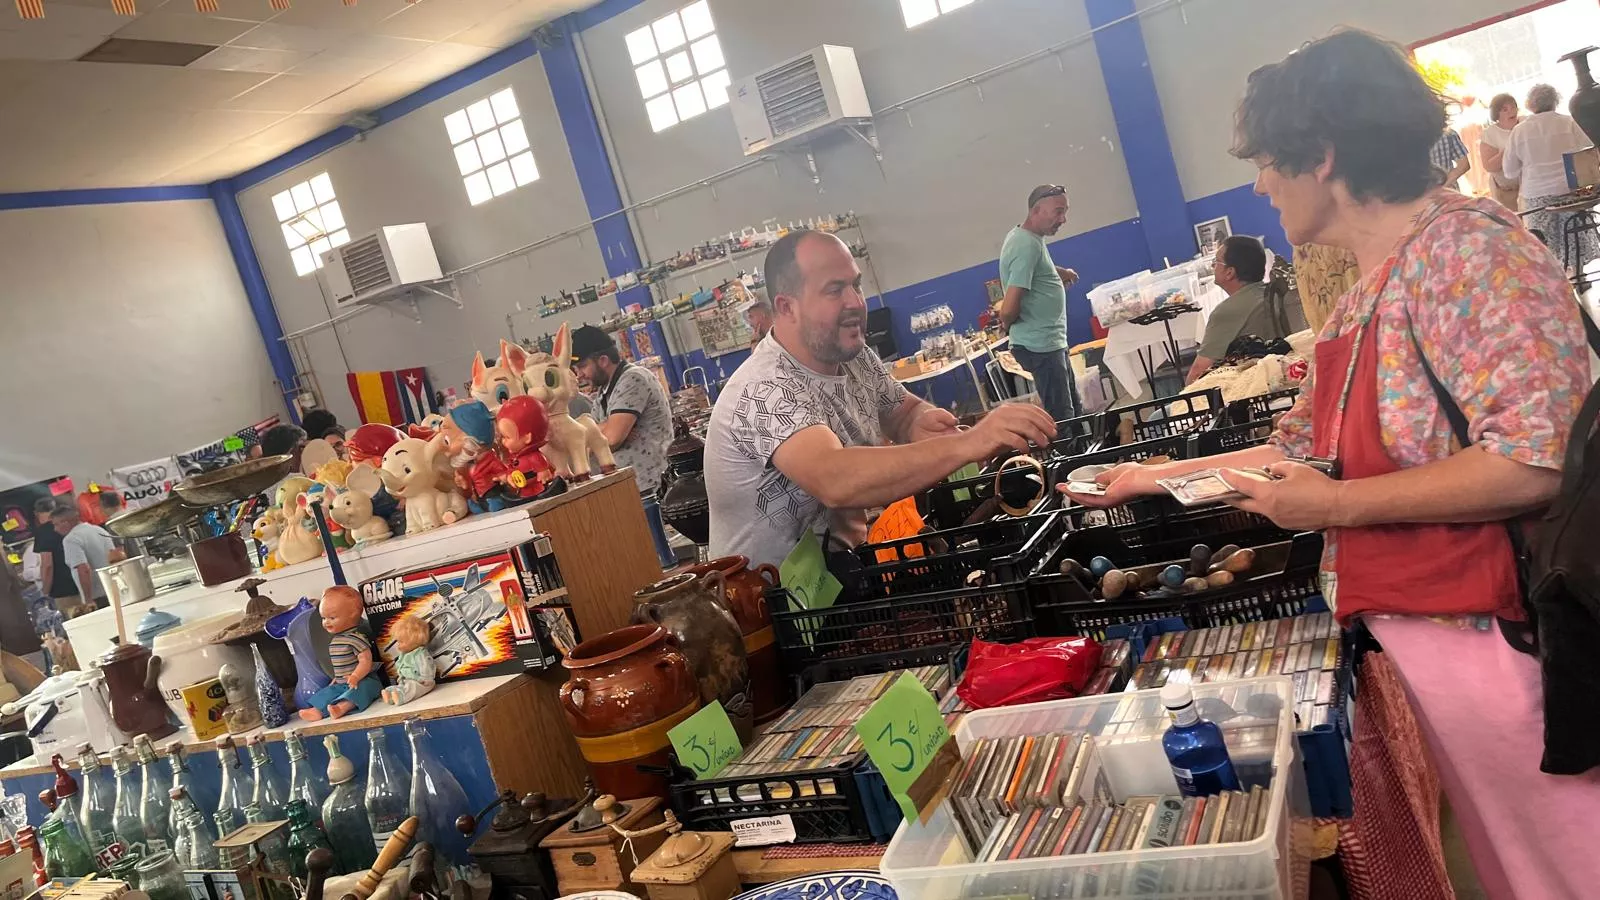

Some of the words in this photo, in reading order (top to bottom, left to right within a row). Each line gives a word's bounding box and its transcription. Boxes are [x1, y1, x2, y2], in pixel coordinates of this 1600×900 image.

[123, 486, 163, 501] Audi
[366, 599, 403, 616] SKYSTORM
[733, 819, 782, 831] NECTARINA
